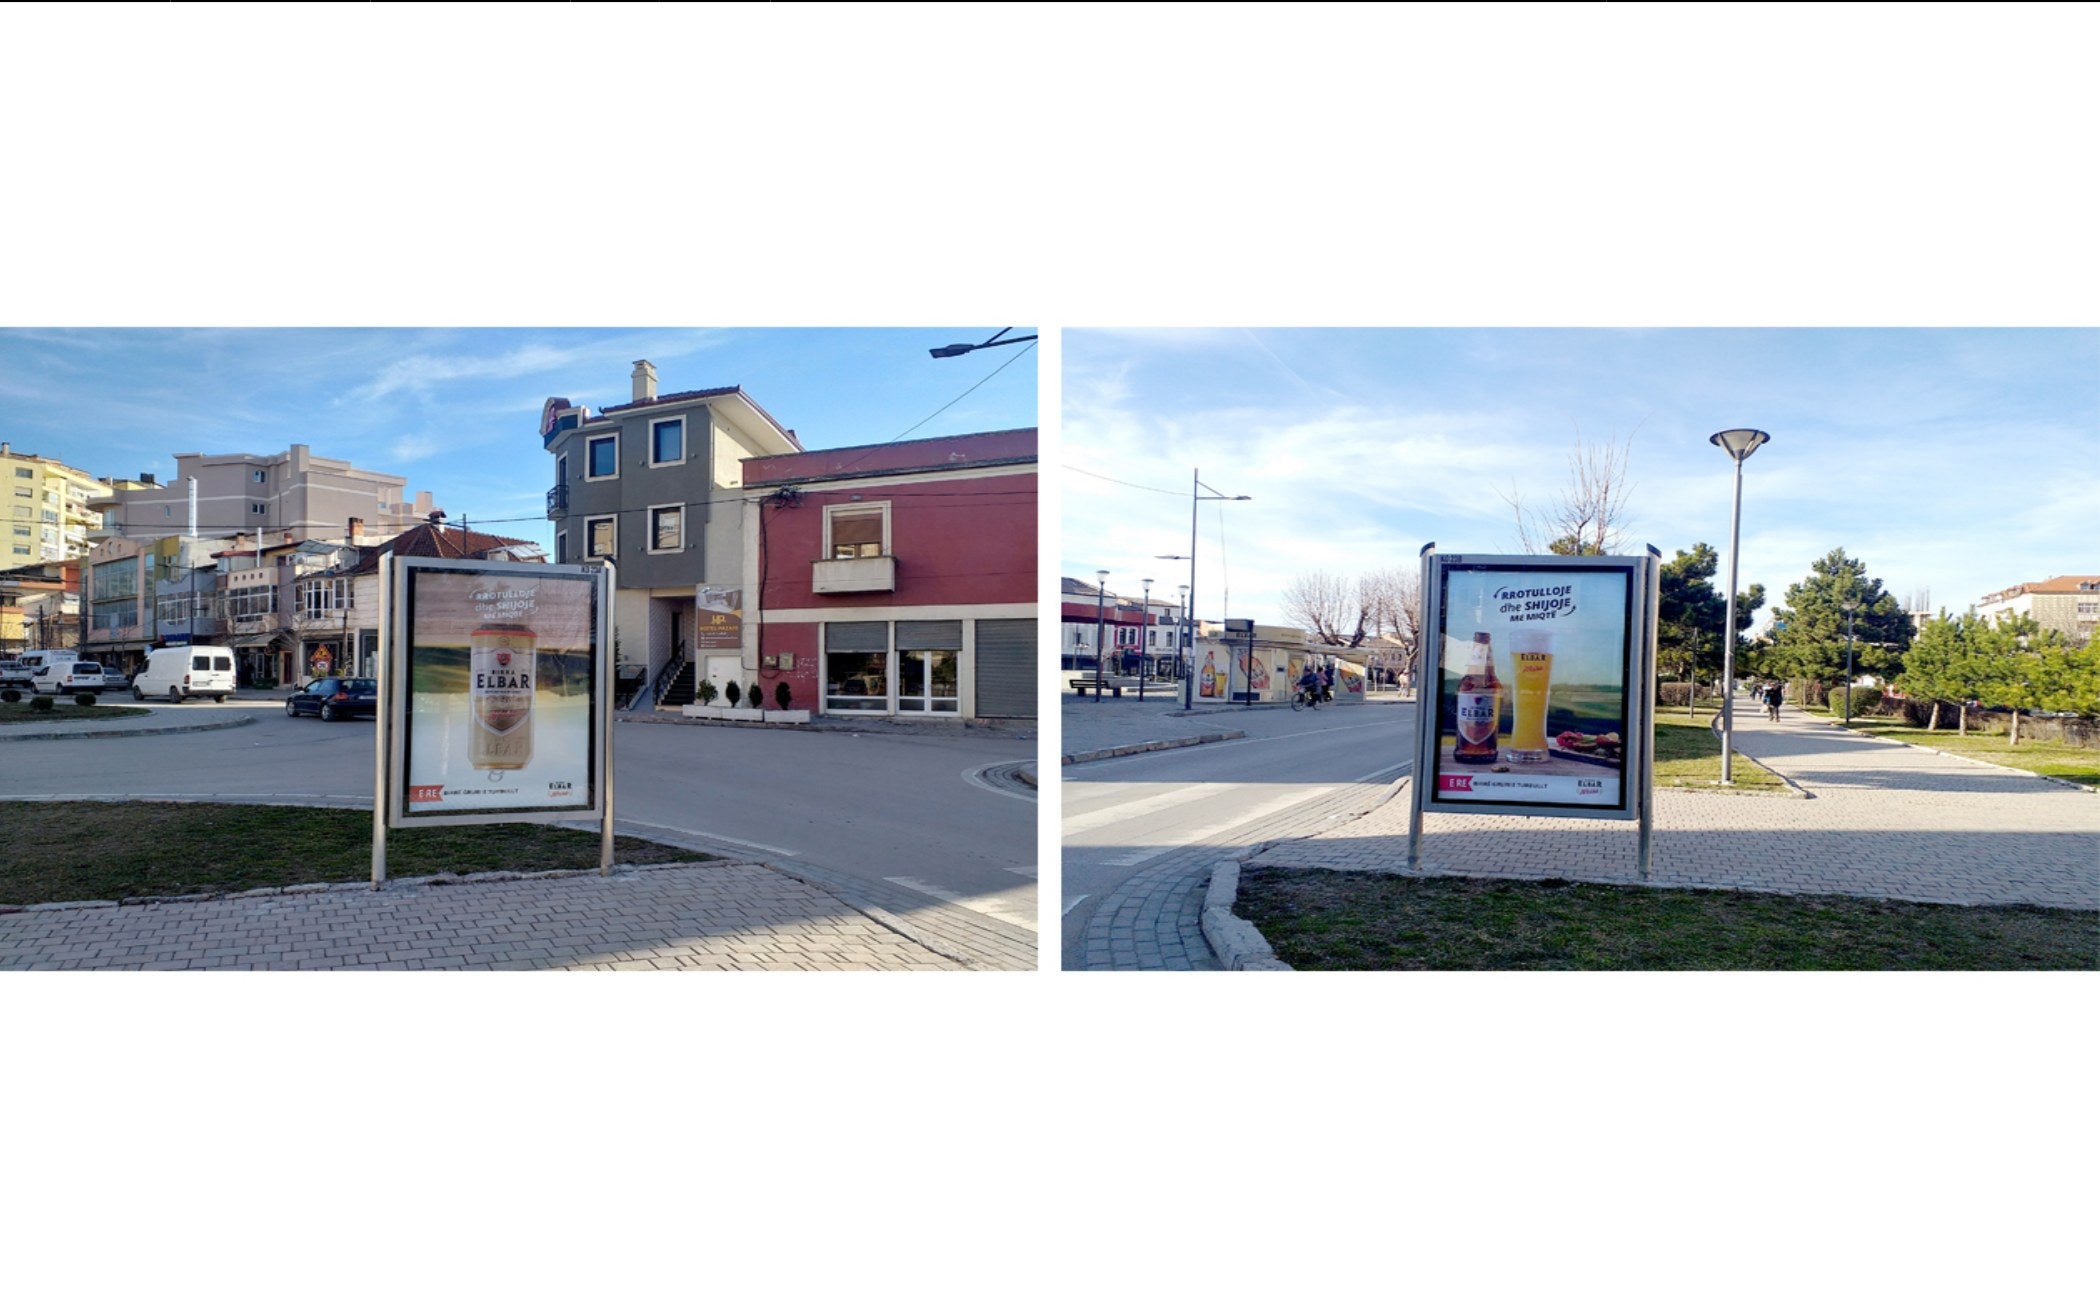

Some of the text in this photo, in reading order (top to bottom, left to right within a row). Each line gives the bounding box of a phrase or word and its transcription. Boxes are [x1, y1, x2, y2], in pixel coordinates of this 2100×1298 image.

[1501, 585, 1572, 600] RROTULLOJE
[1500, 598, 1571, 613] dhe SHIJOJE
[1510, 614, 1524, 622] ME
[477, 673, 530, 689] ELBAR
[1461, 707, 1494, 718] ELBAR
[1456, 779, 1467, 788] RE
